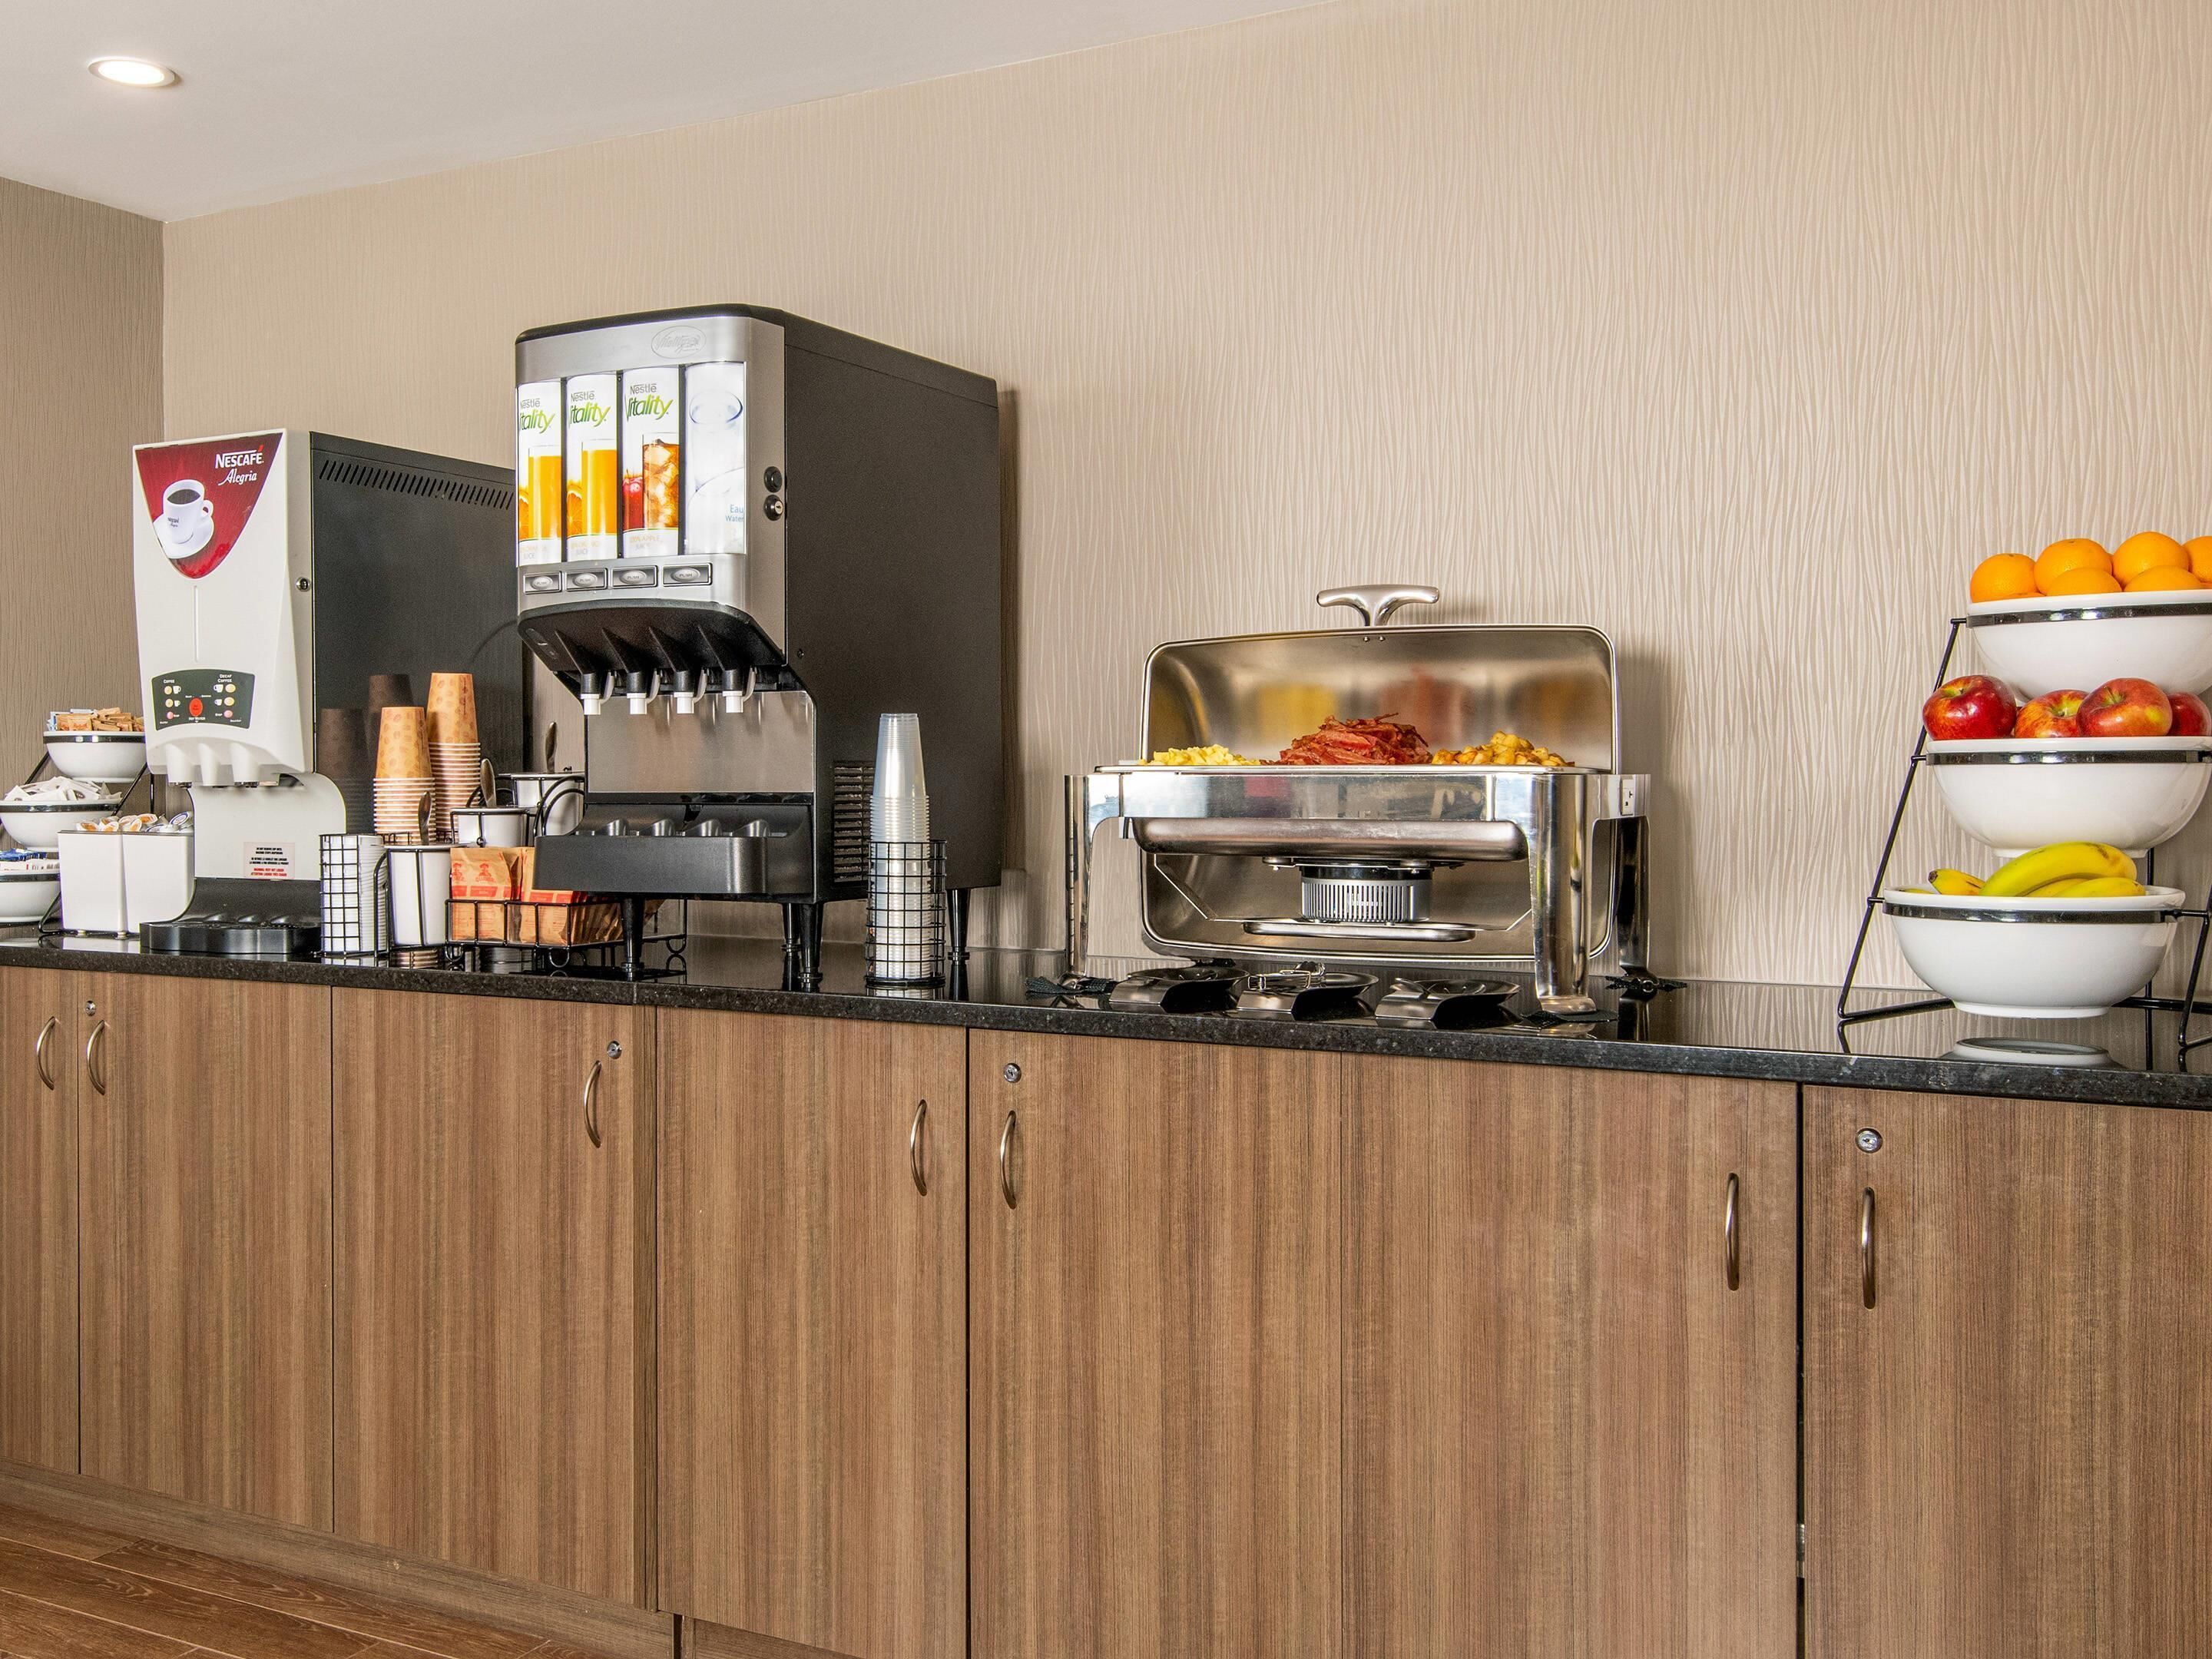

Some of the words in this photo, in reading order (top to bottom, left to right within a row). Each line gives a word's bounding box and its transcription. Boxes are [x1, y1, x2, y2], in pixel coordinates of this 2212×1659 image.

[568, 402, 611, 428] itality
[624, 393, 673, 422] Vitality
[518, 409, 555, 434] itality
[215, 445, 263, 469] NESCAFÉ
[217, 469, 257, 485] Alegria
[730, 504, 744, 513] Eau
